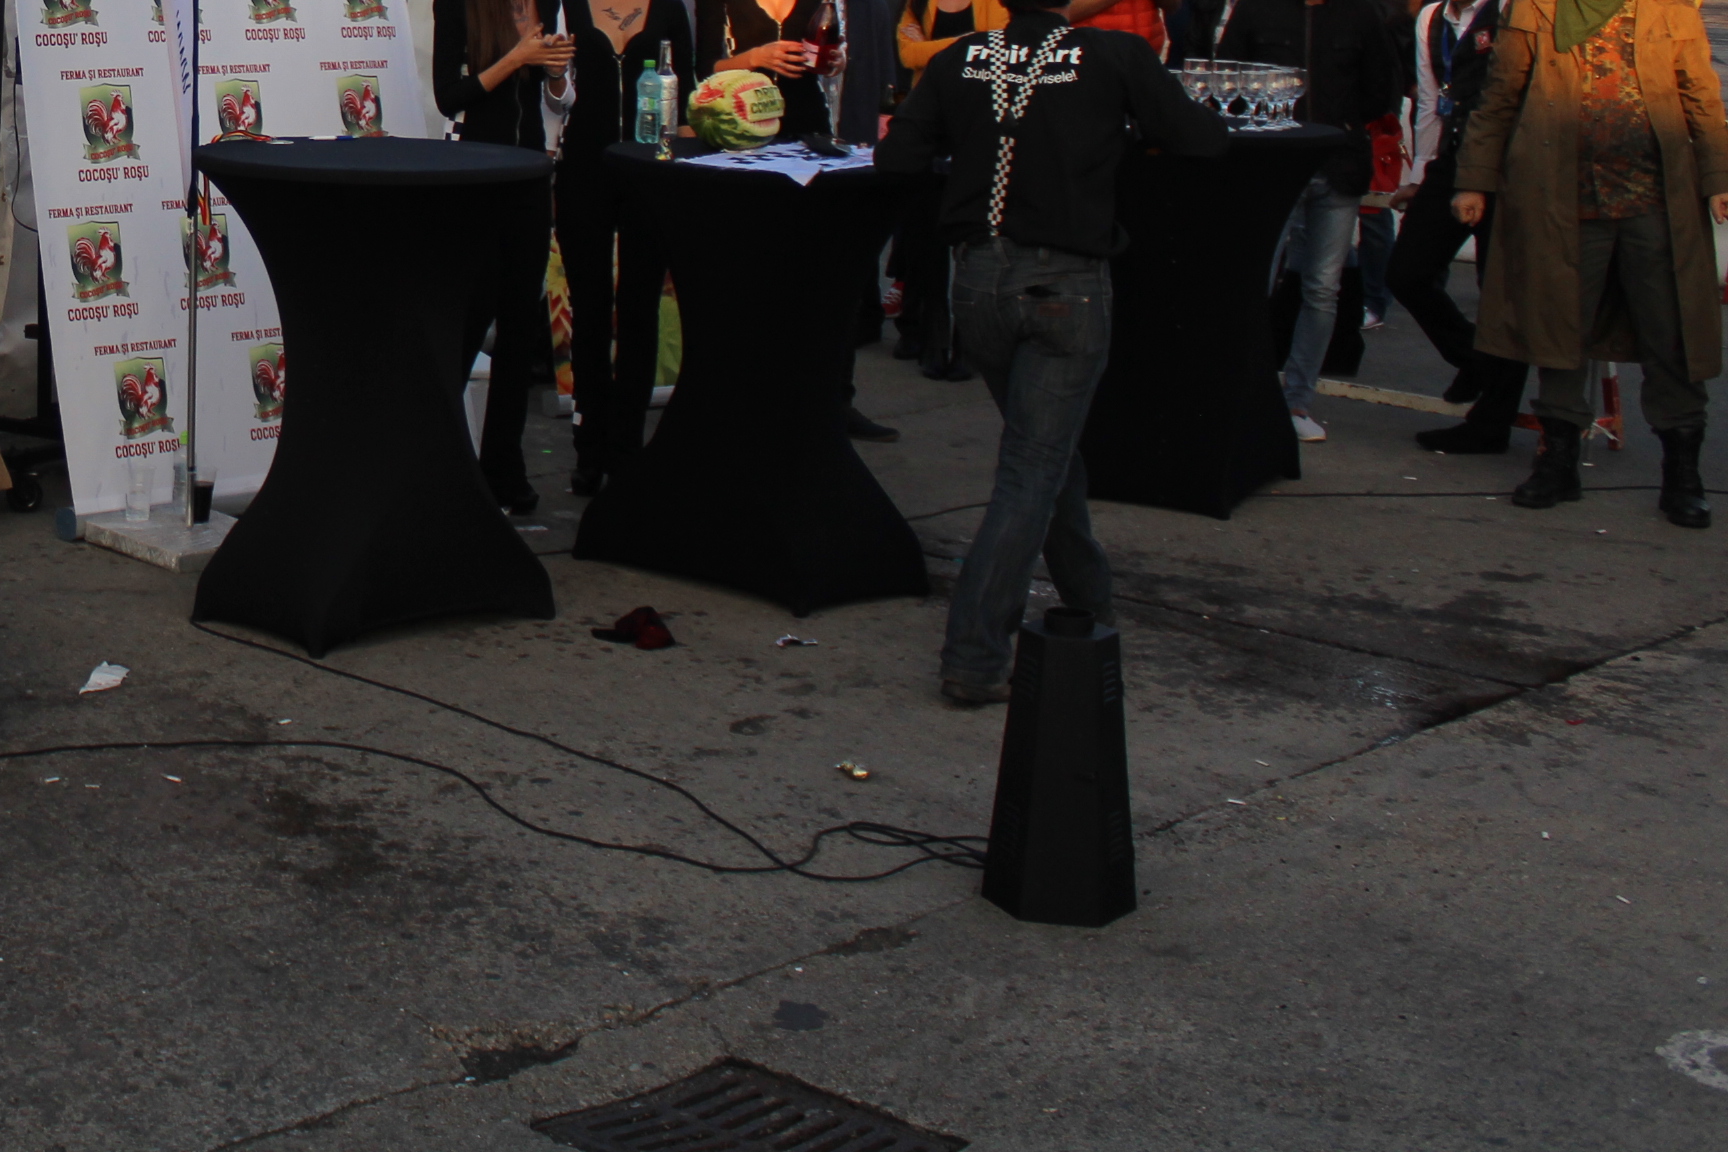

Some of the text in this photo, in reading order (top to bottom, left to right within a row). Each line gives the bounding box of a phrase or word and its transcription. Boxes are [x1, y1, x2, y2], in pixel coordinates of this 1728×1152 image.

[198, 64, 271, 75] FERMA RESTAURANT
[319, 60, 388, 71] FERMA RESTAURANT
[60, 68, 144, 81] FERMA RESTAURANT
[48, 204, 134, 219] FERMA RESTAURANT
[231, 332, 255, 342] FERMA
[94, 339, 177, 356] FERMA RESTAURANT
